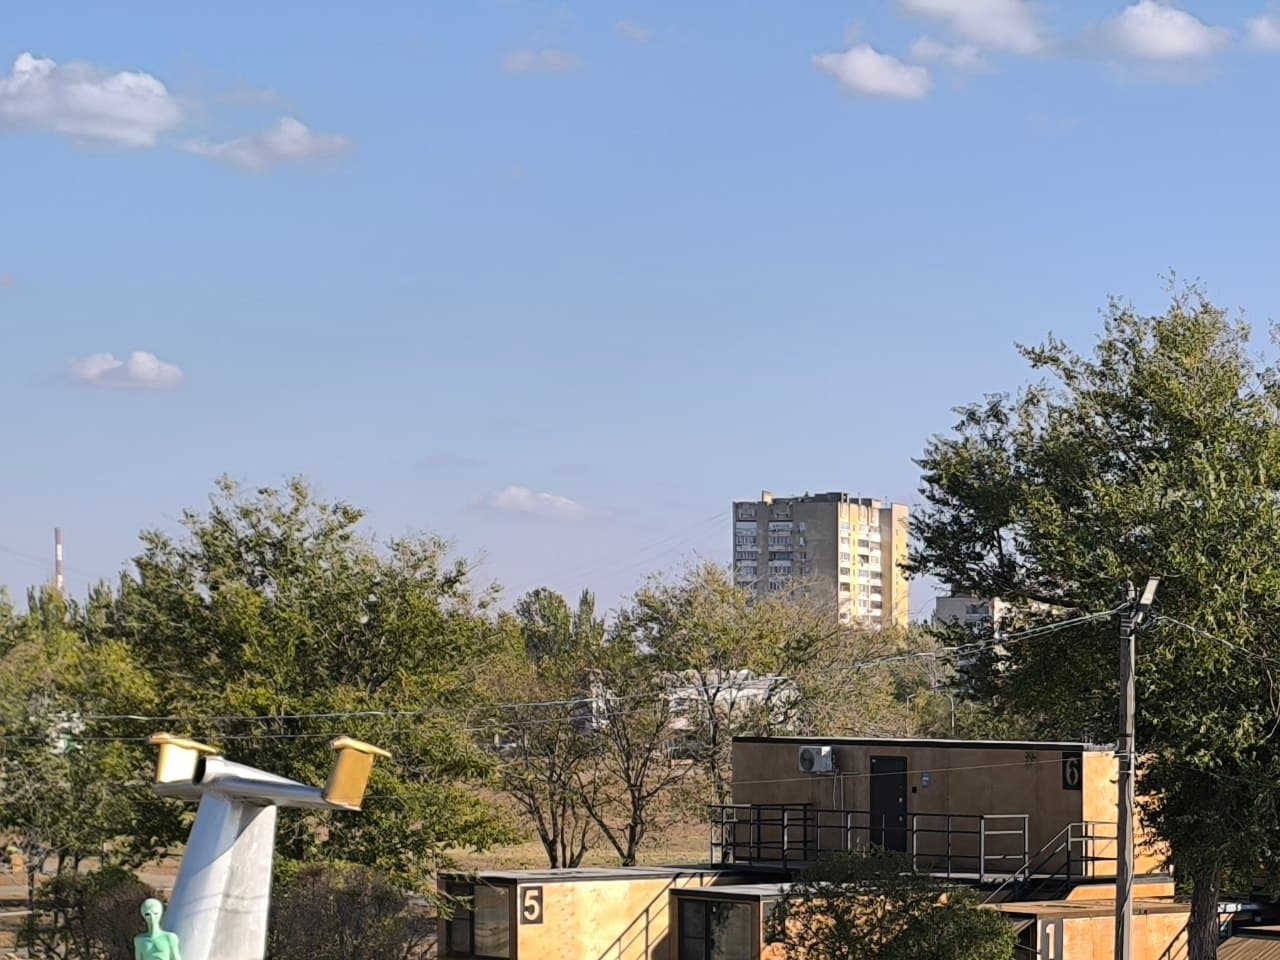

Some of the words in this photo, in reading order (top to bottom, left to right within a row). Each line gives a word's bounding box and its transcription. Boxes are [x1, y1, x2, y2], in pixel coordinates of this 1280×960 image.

[1065, 757, 1079, 786] 6
[523, 889, 540, 921] 5
[1045, 923, 1056, 960] 1
